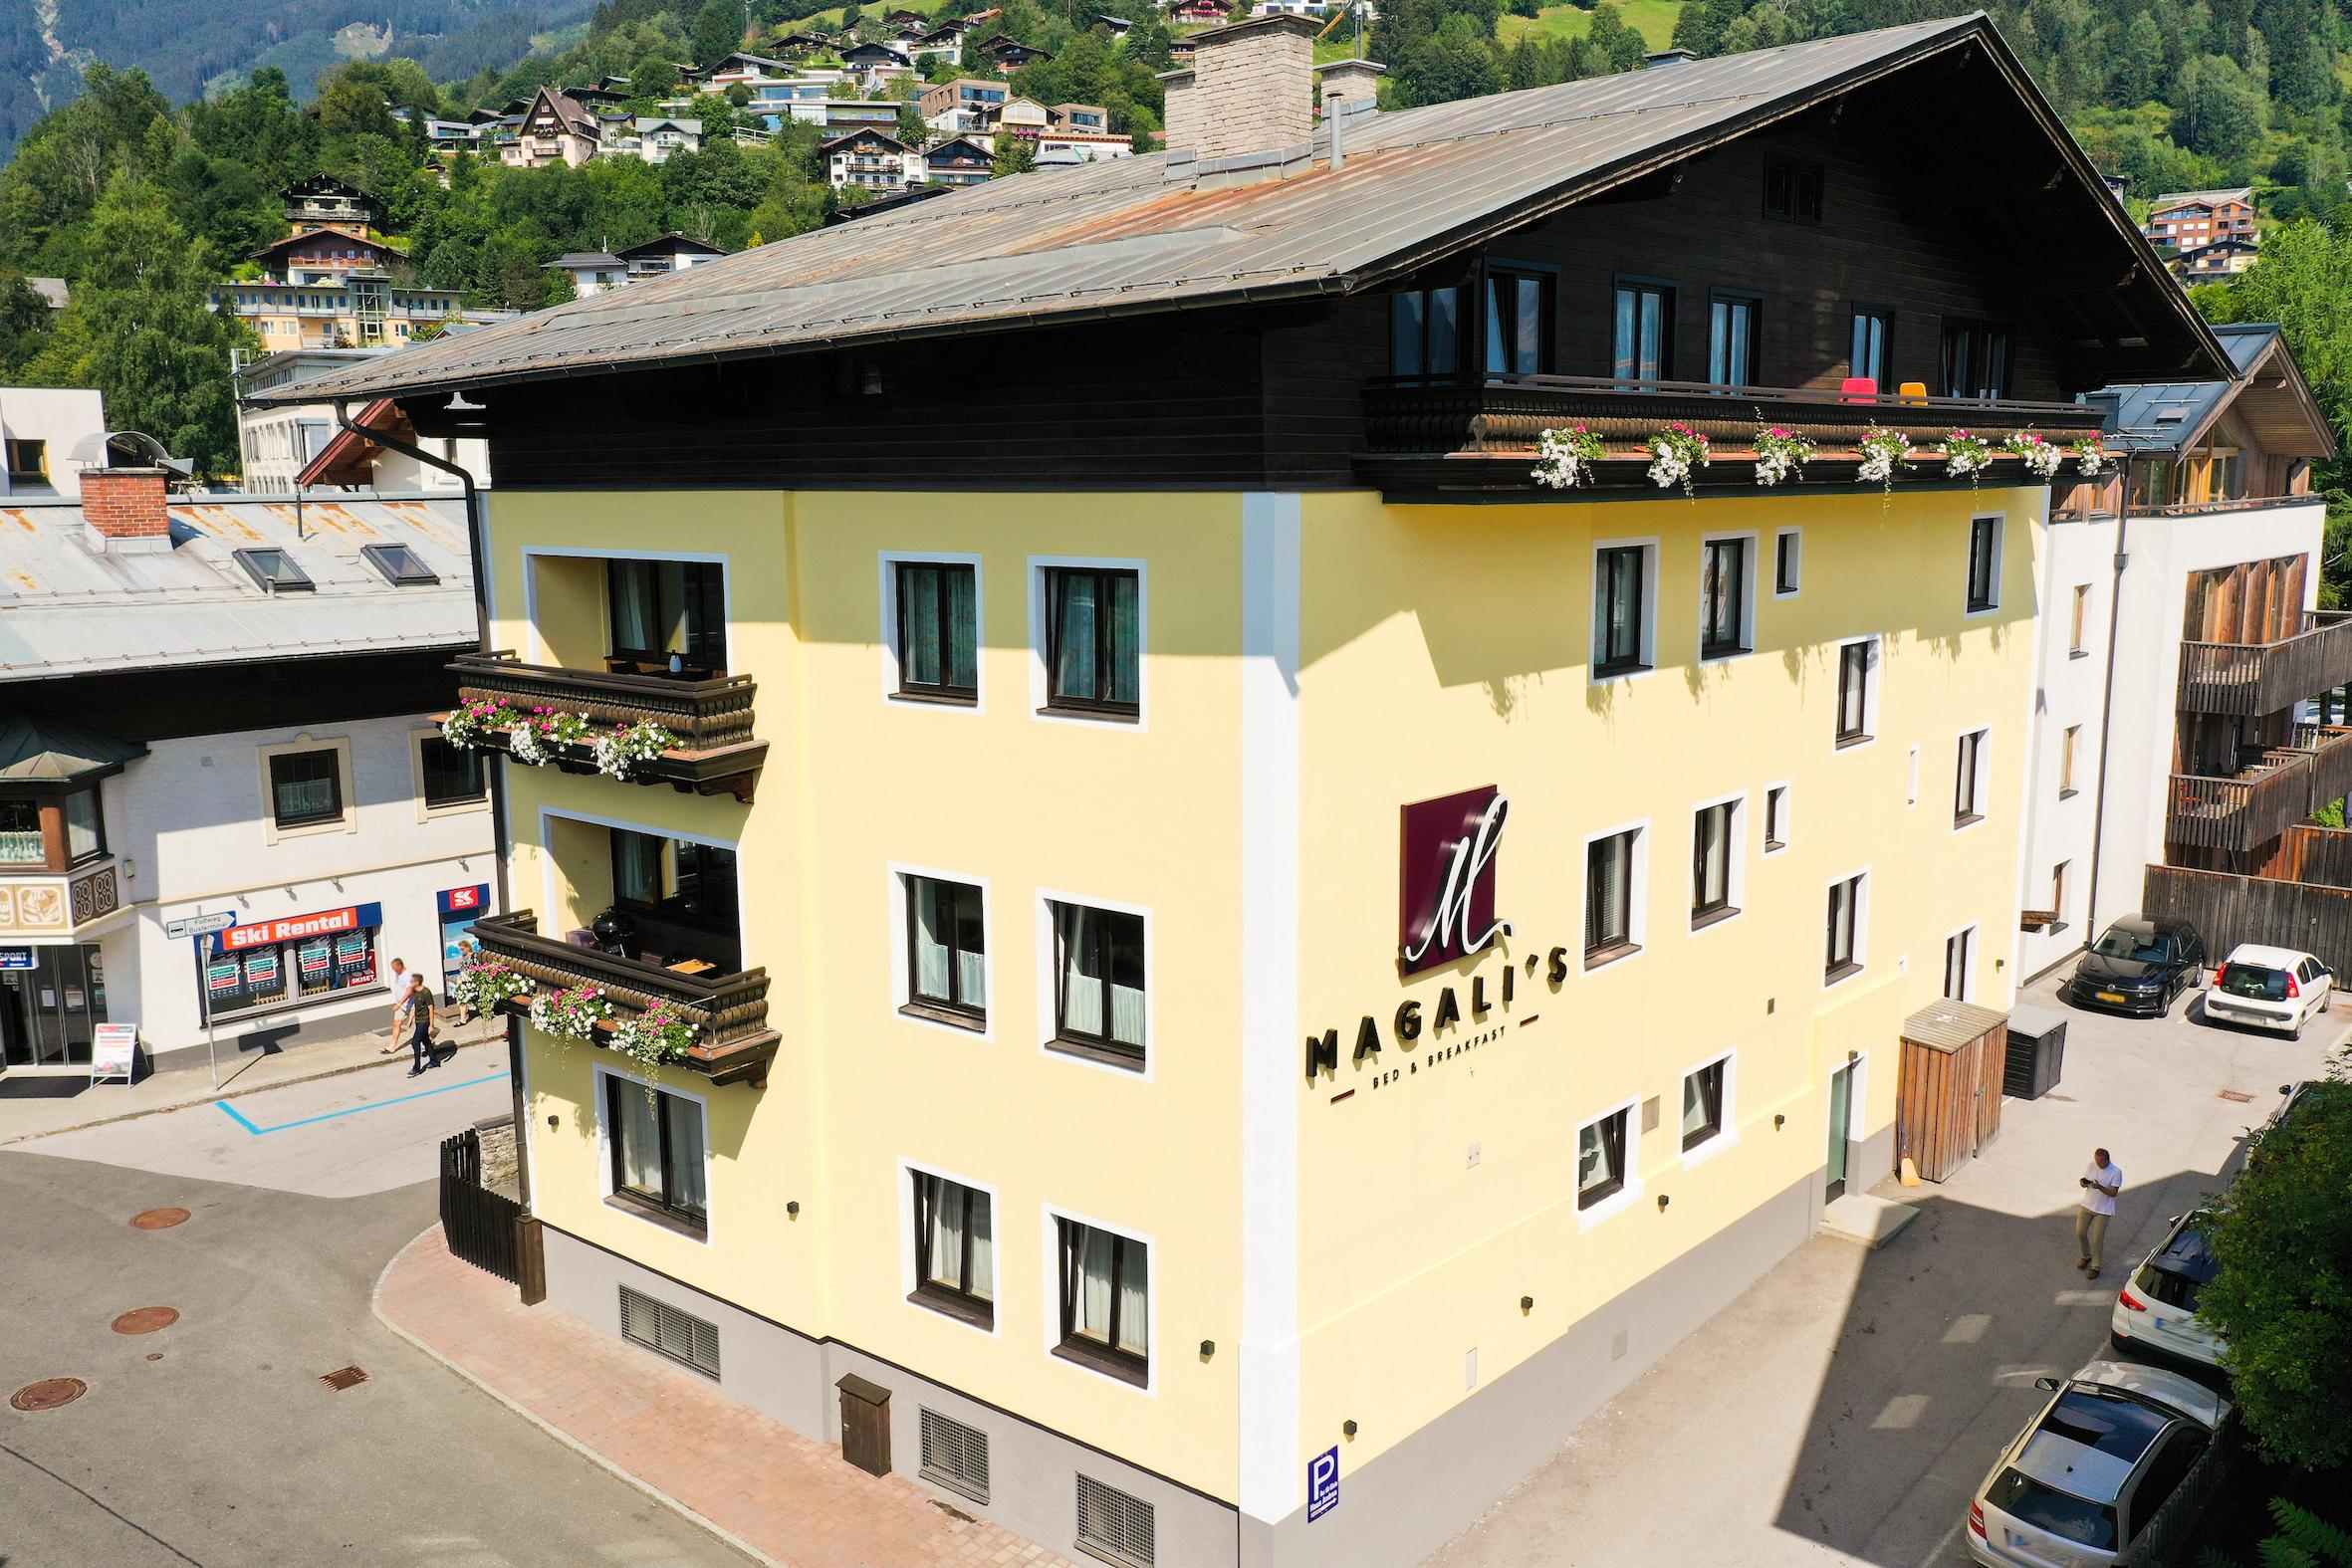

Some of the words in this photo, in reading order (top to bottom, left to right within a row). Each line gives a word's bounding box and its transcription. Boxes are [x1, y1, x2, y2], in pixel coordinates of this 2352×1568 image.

[188, 921, 228, 934] Busterminal
[231, 925, 270, 947] Ski
[275, 911, 350, 939] Rental
[351, 974, 375, 985] SKISET
[1305, 947, 1567, 1078] MAGALI'S
[1372, 1068, 1400, 1090] BED
[1410, 1061, 1417, 1075] &
[1428, 1025, 1506, 1068] BREAKFAST
[1313, 1454, 1335, 1503] P
